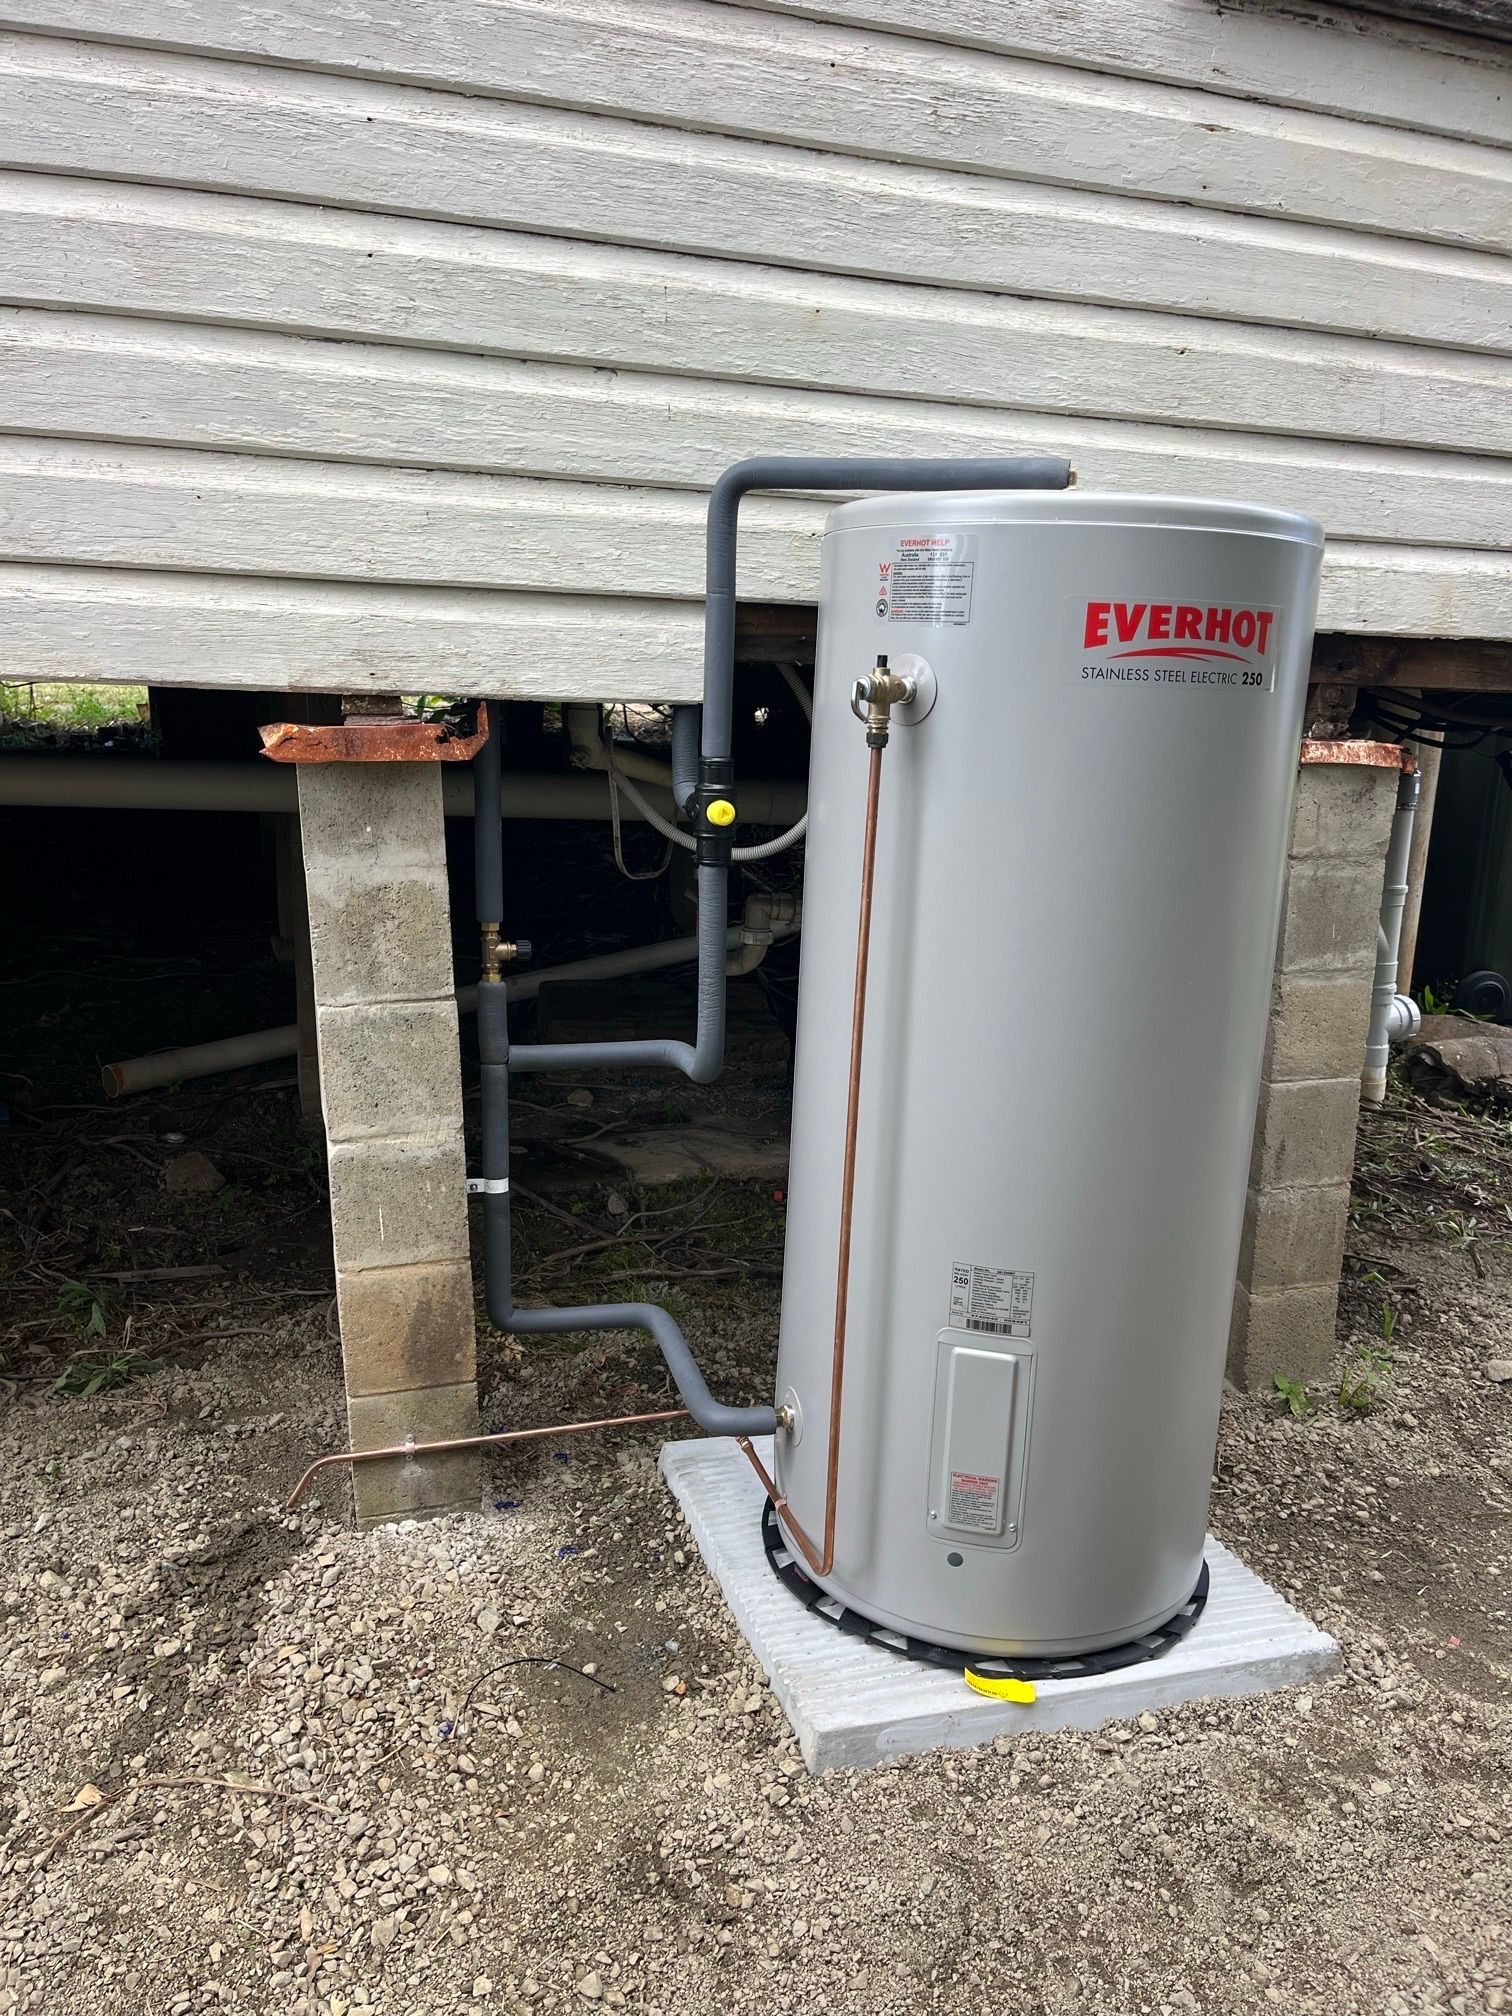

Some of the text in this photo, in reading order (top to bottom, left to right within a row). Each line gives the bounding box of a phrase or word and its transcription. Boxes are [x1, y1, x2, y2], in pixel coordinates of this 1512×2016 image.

[900, 538, 950, 547] EVERHOT HELP
[1083, 602, 1274, 656] EVERHOT
[1081, 666, 1263, 686] STAINLESS STEEL ELECTRIC 250
[953, 1275, 969, 1286] 250
